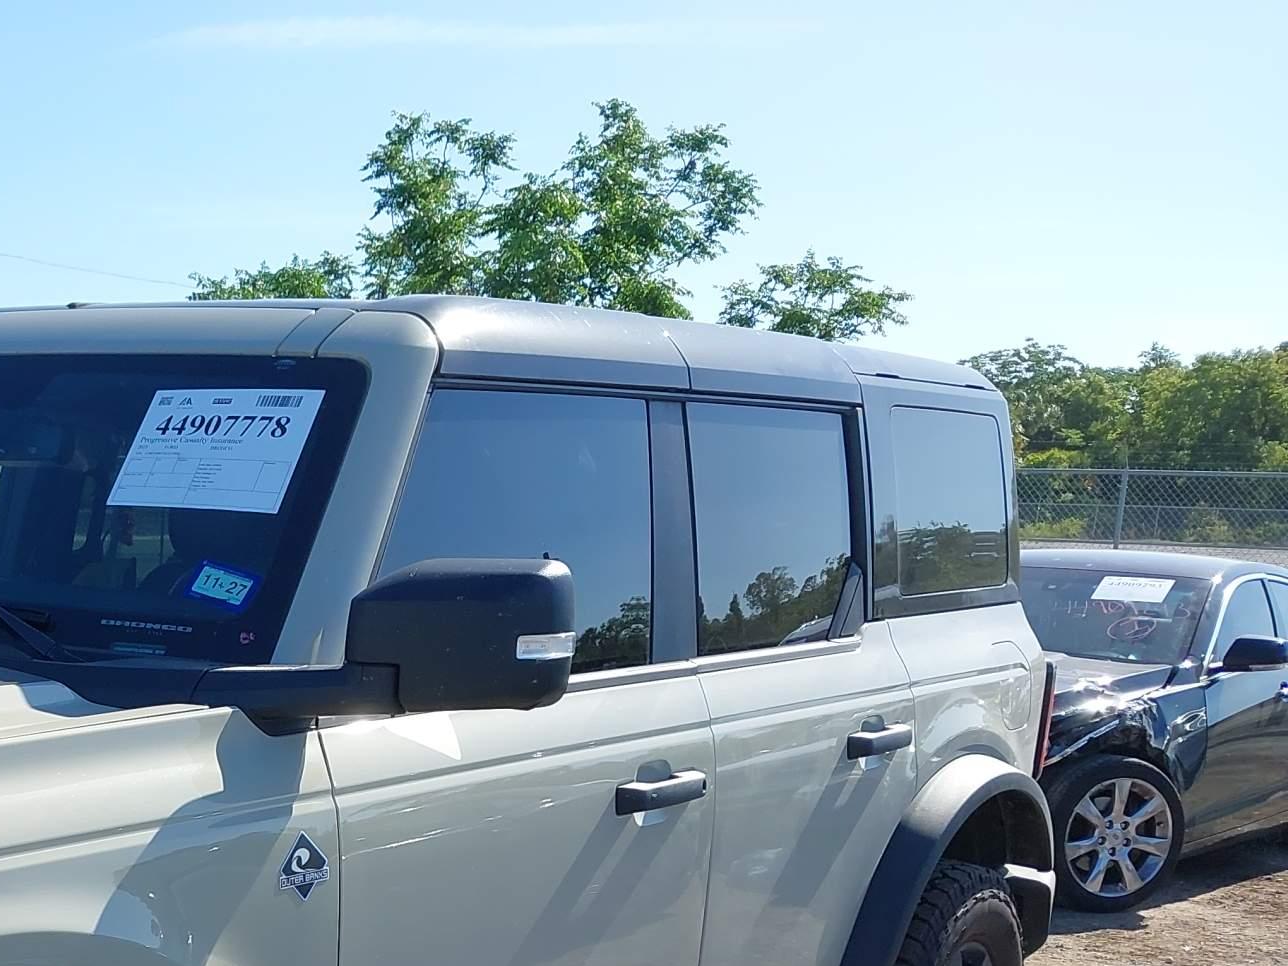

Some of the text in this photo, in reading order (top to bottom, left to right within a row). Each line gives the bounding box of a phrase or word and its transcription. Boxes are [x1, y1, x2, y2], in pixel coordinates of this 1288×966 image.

[156, 415, 291, 438] 44907778
[140, 436, 243, 446] Progressive Casualty Insurance
[202, 574, 248, 597] 11 27
[101, 618, 193, 633] BRONCO
[281, 870, 328, 887] OUTER BANKS
